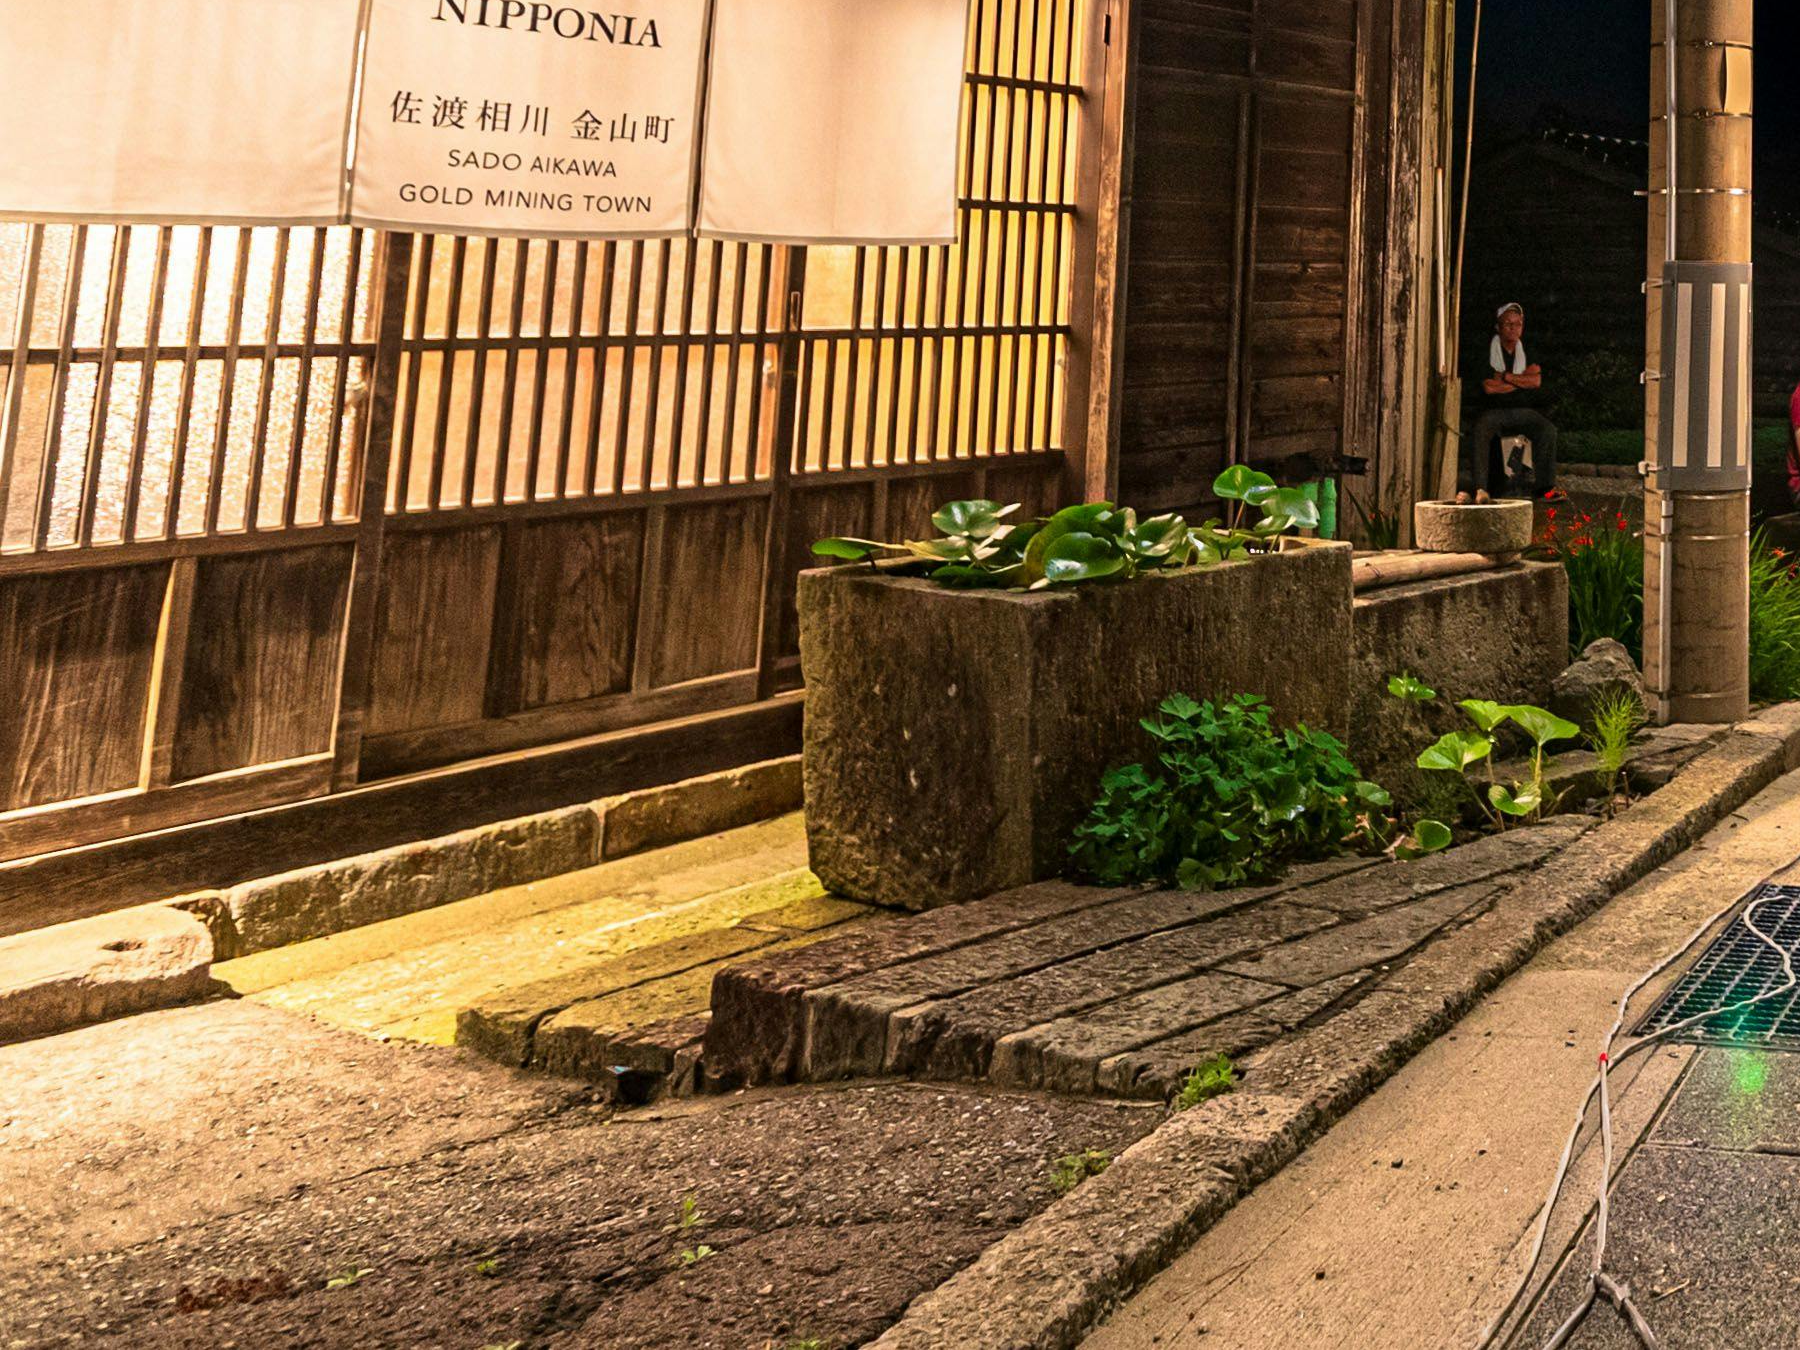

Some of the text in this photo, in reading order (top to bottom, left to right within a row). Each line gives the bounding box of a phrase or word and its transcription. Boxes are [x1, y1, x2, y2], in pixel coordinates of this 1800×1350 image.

[389, 89, 676, 145] 佐渡相川 金山町
[447, 148, 618, 178] SADO AIKAWA
[398, 182, 653, 214] GOLD MINING TOWN
